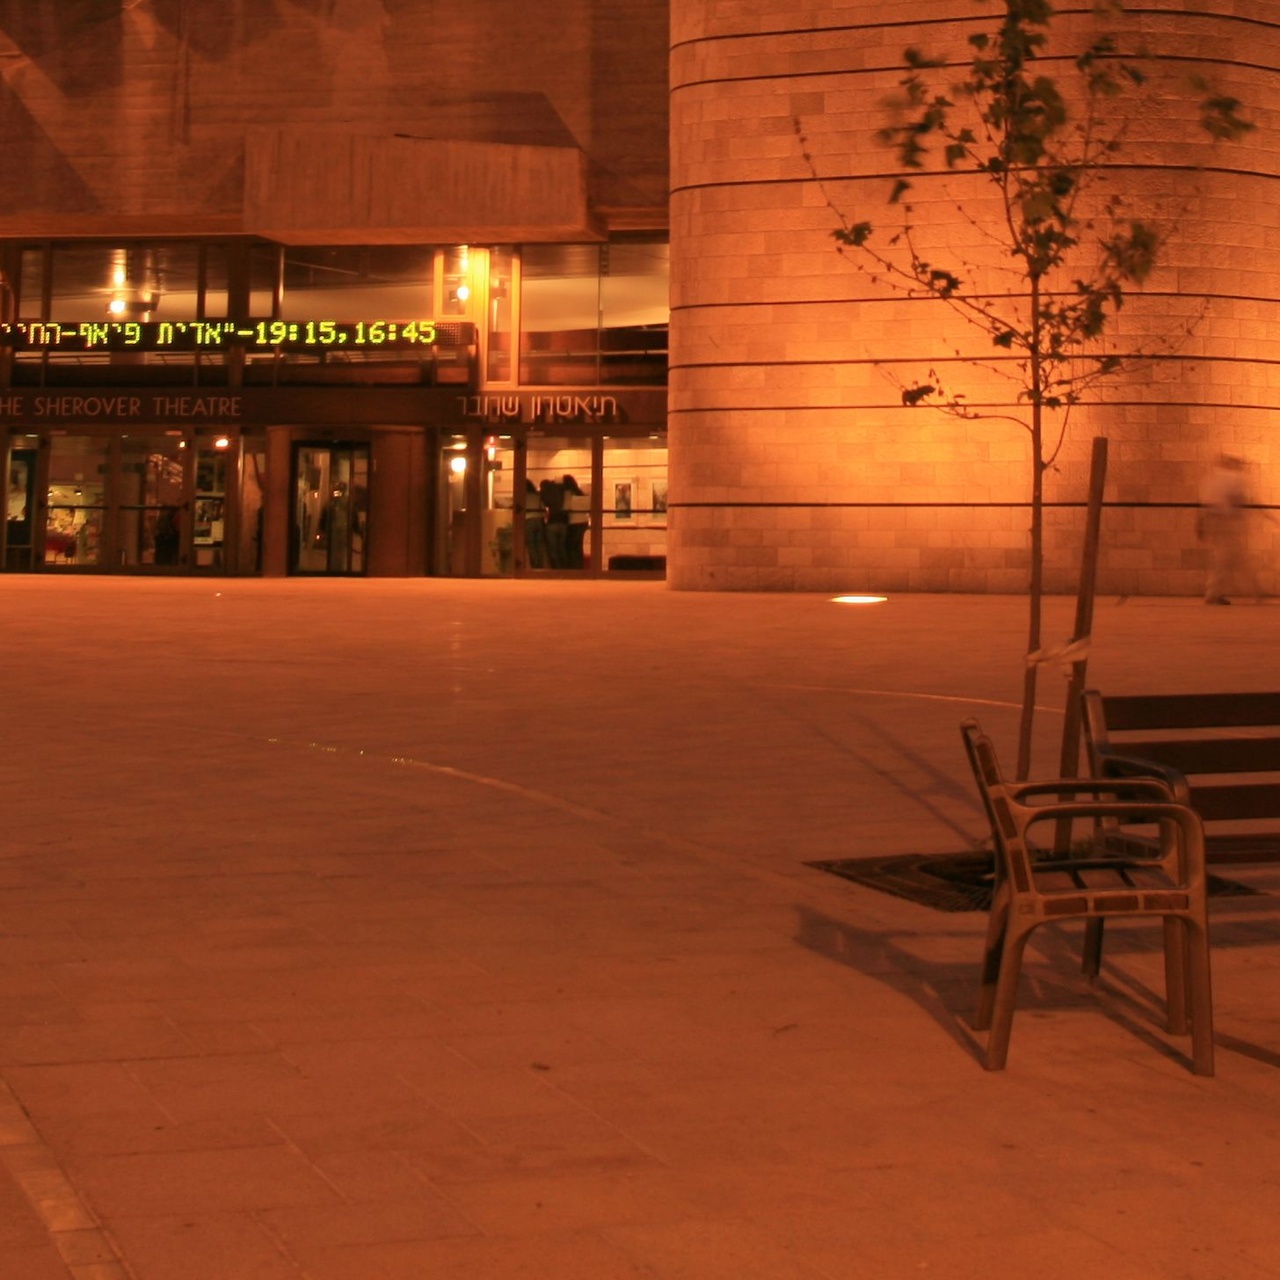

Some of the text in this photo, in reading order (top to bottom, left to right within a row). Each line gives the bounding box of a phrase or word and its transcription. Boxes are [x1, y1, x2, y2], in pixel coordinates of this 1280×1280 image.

[34, 397, 141, 416] SHEROVER
[153, 397, 242, 416] THEATRE
[456, 396, 617, 419] תיאטרון שרובר
